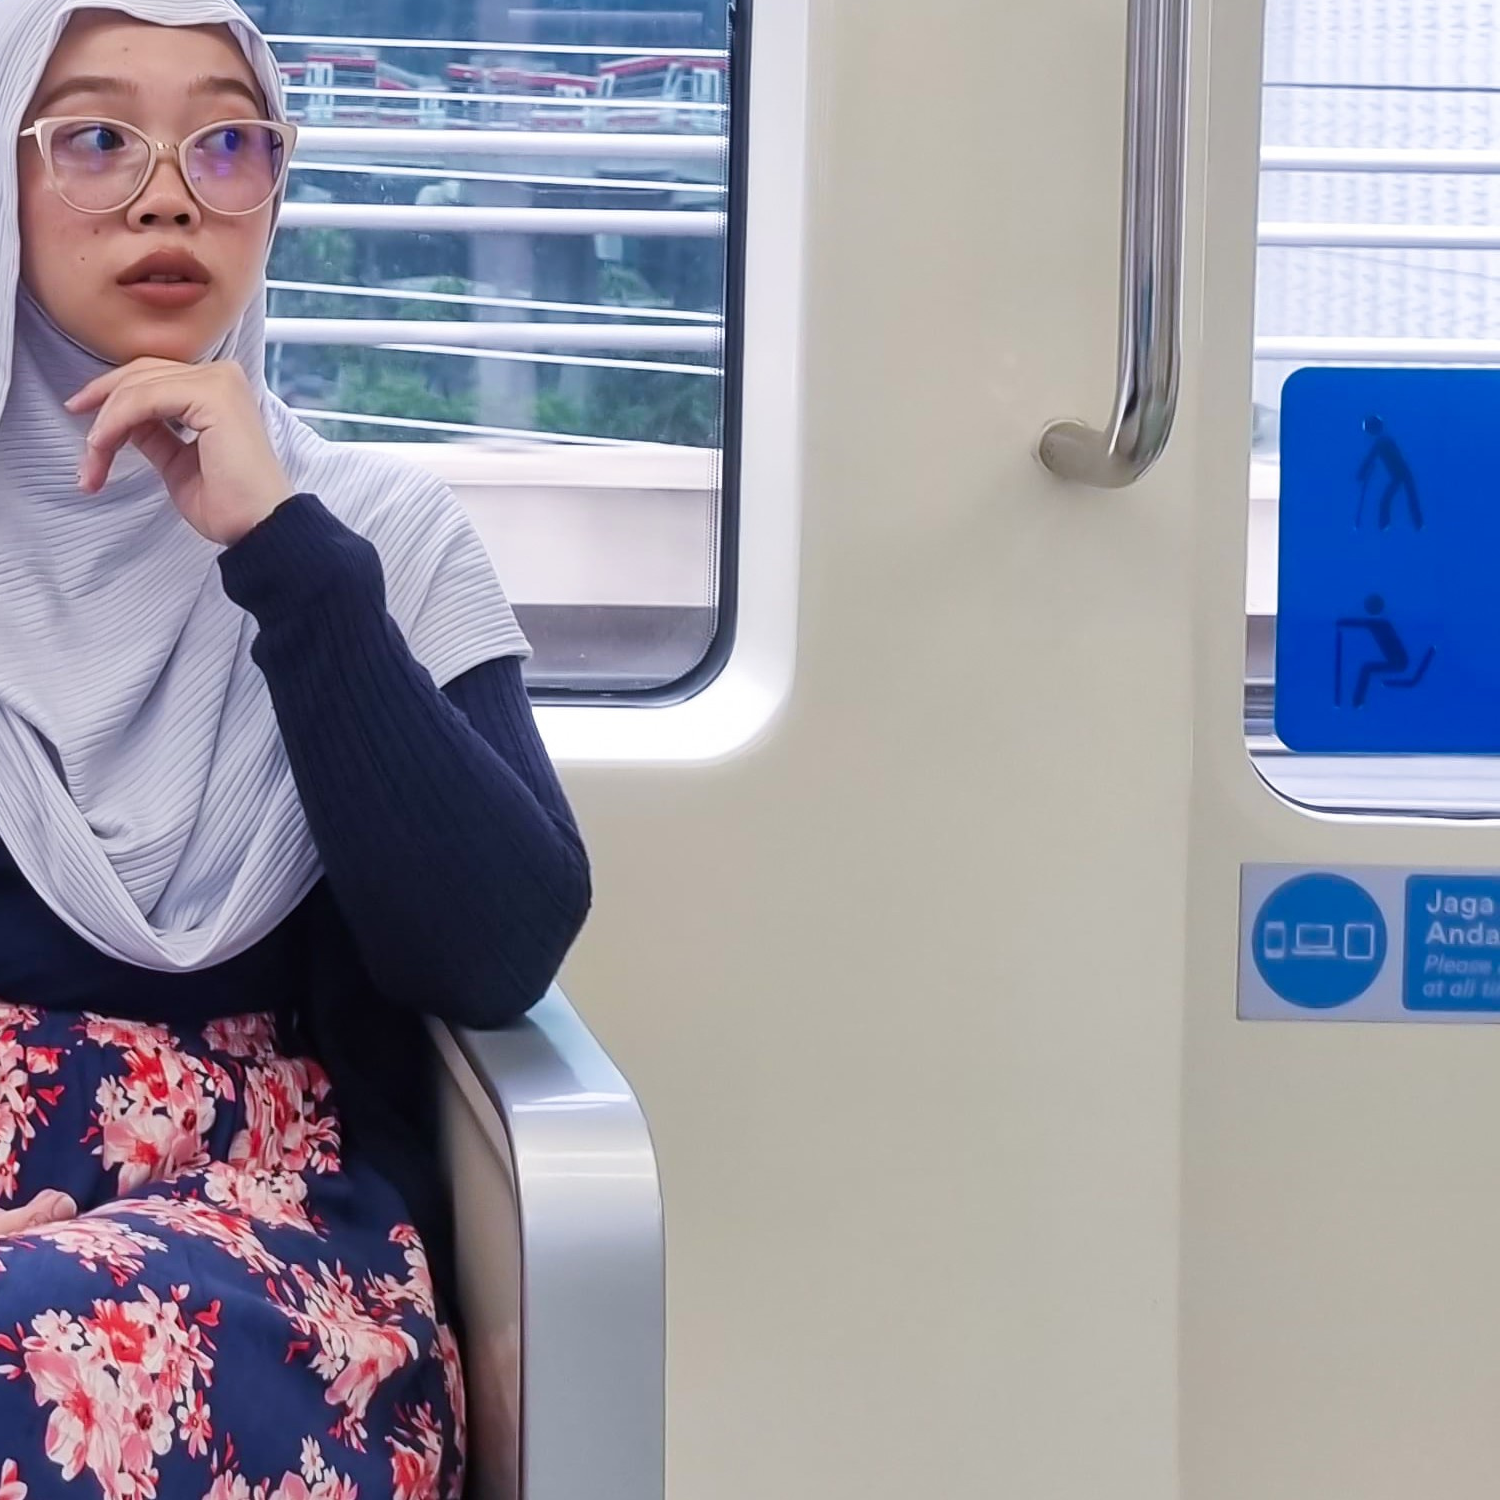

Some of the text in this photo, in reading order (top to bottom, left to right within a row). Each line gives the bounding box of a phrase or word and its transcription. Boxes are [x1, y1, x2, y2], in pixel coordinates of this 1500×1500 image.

[1425, 888, 1494, 920] Jaga
[1424, 920, 1500, 946] Anda
[1422, 979, 1445, 998] at
[1449, 978, 1477, 999] all
